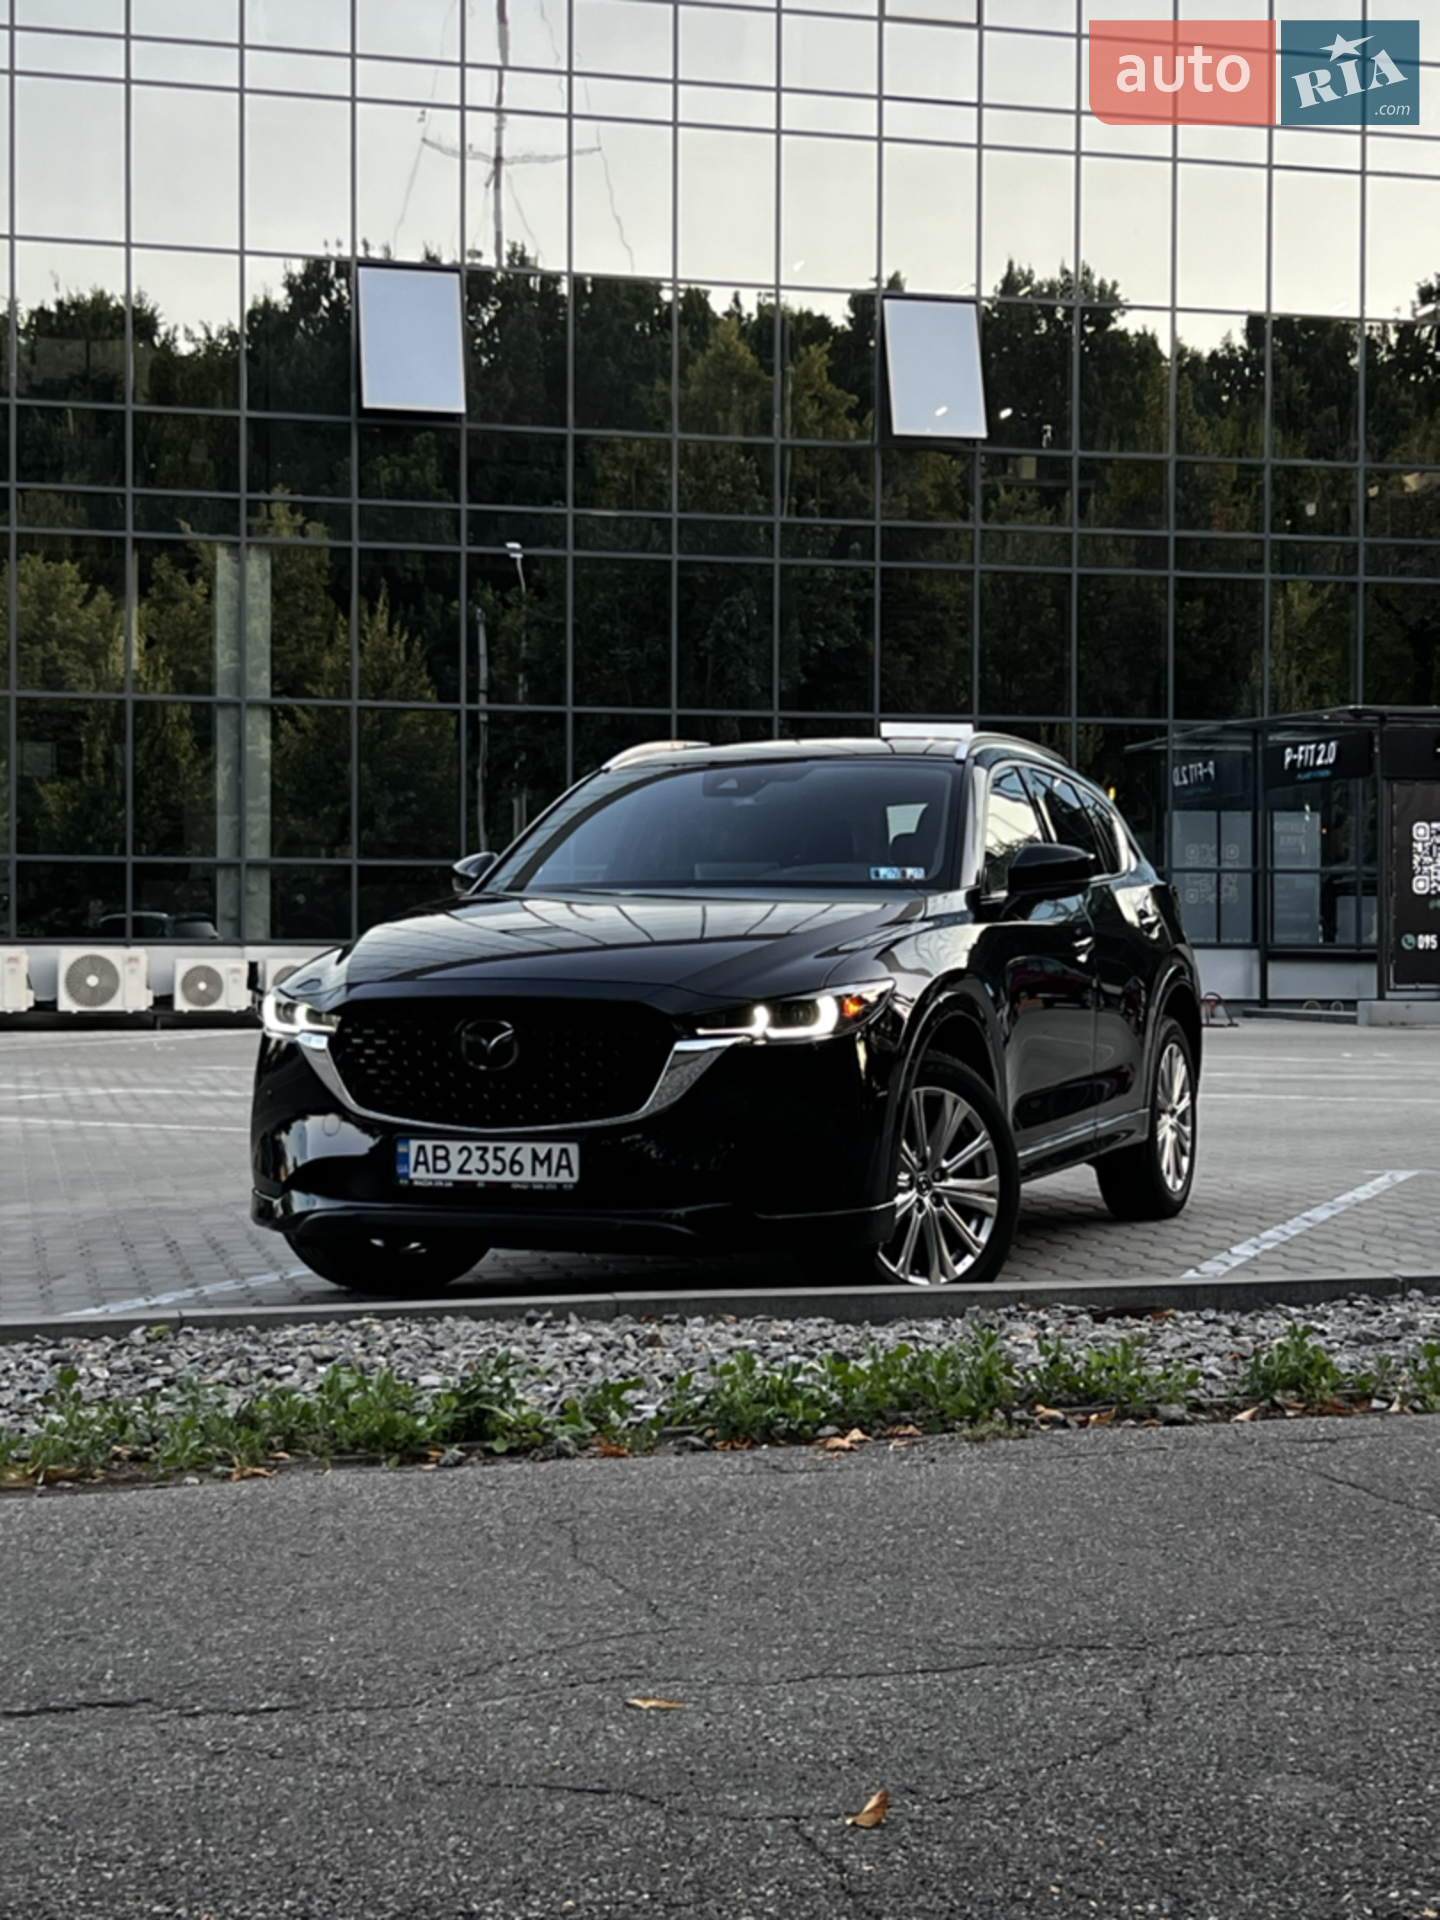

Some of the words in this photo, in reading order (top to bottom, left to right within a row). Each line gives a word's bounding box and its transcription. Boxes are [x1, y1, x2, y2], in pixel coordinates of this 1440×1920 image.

[412, 1144, 451, 1174] AB
[456, 1145, 525, 1177] 2356
[530, 1146, 575, 1178] MA
